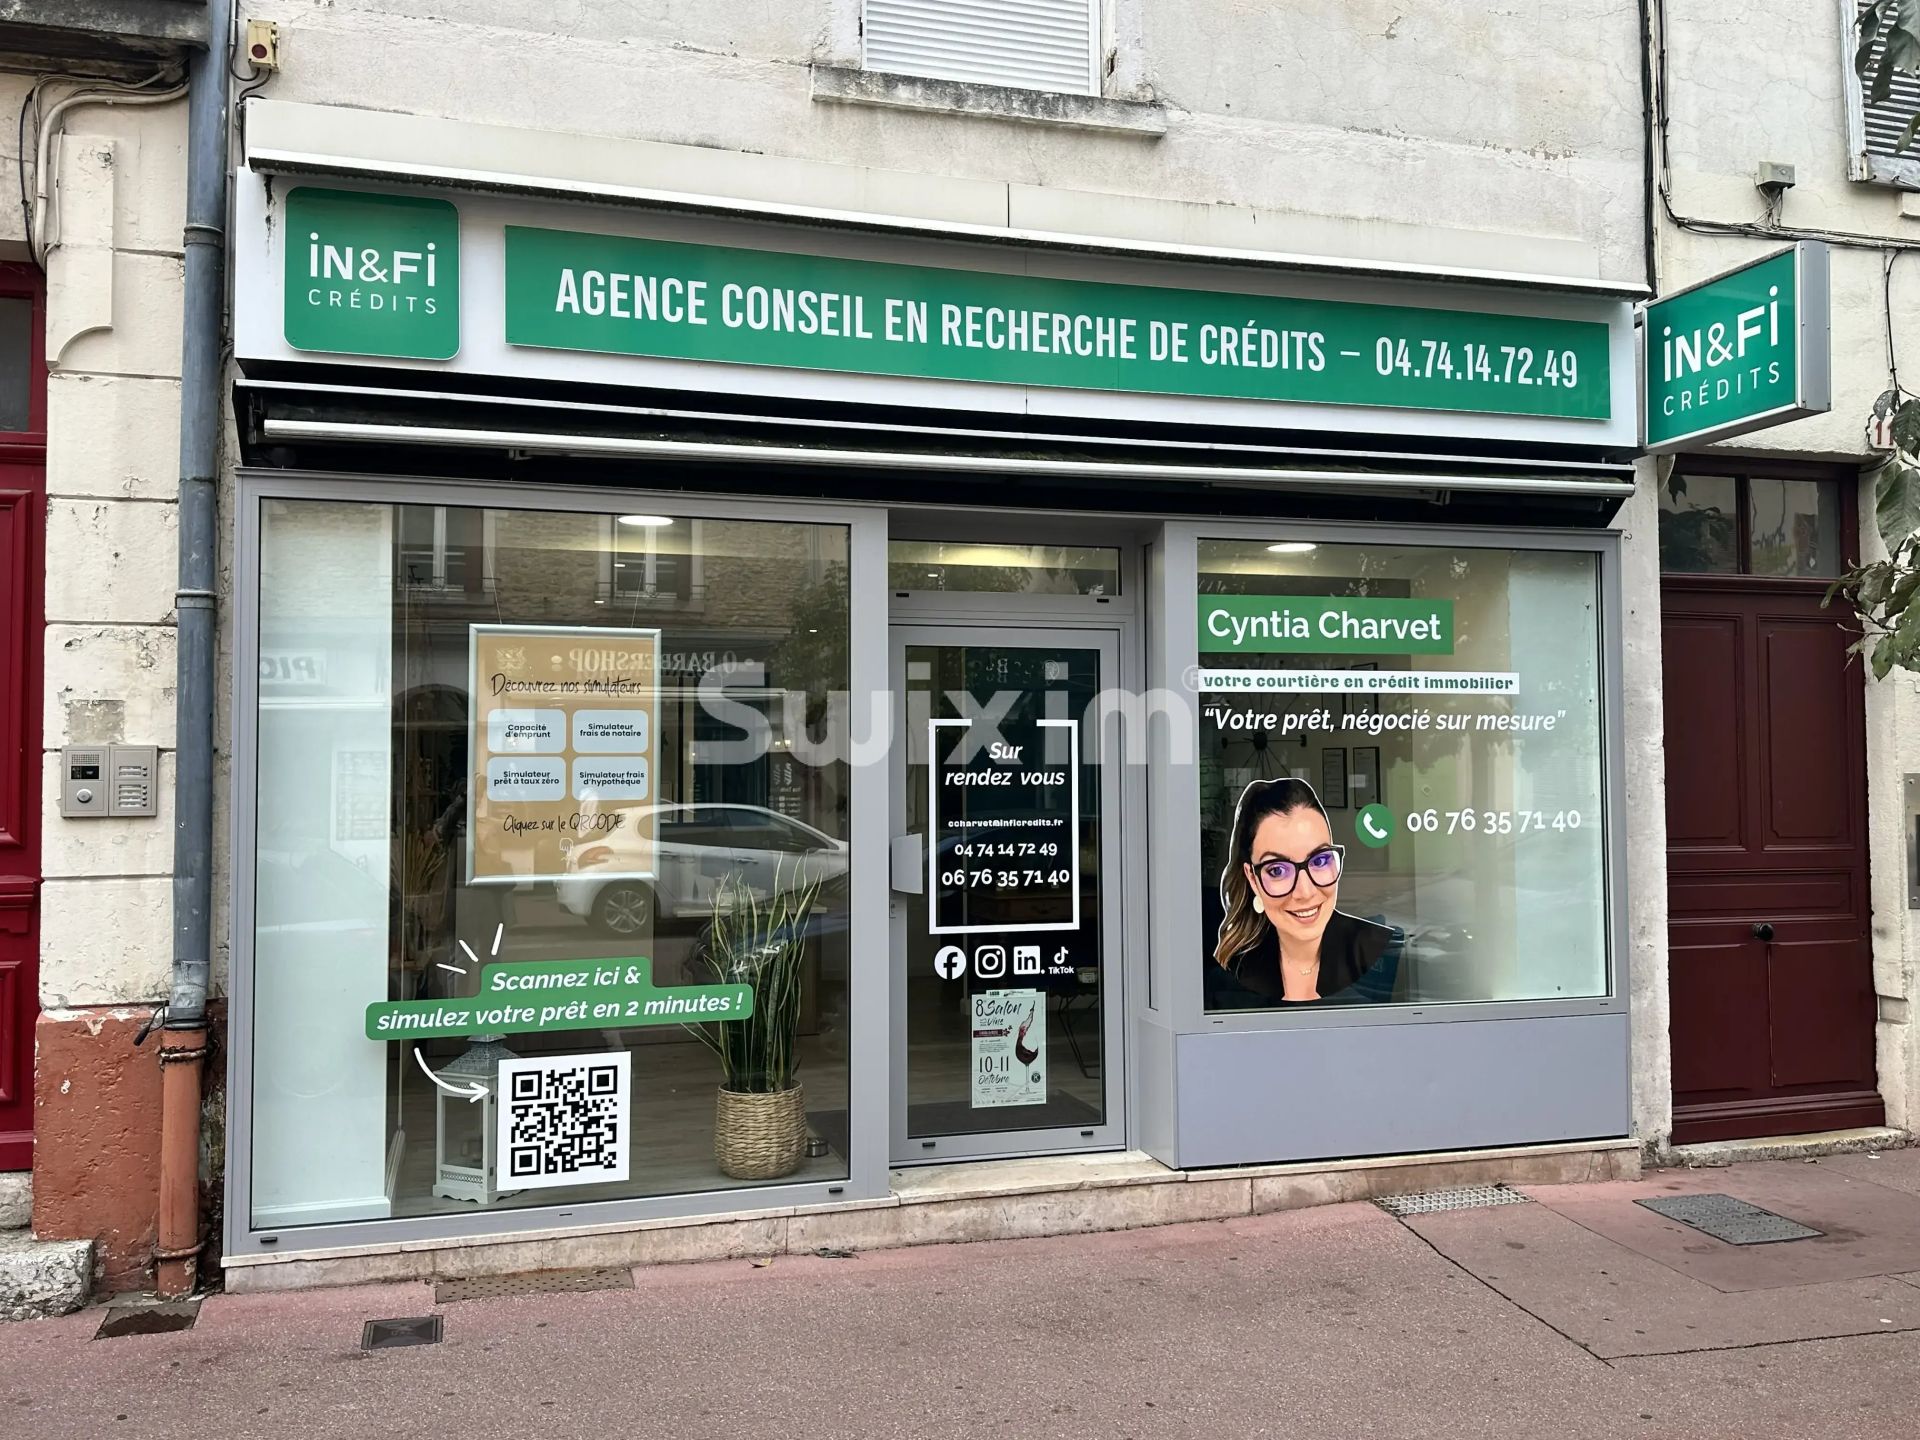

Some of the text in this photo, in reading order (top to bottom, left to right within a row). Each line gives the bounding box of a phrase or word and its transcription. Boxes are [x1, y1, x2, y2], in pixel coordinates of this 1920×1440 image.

[308, 288, 436, 314] CRÉDITS
[555, 267, 707, 325] AGENCE
[722, 282, 873, 339] CONSEIL
[884, 299, 927, 342] EN
[941, 302, 1137, 360] RECHERCHE
[1149, 321, 1188, 362] DE
[1199, 318, 1327, 372] CRÉDITS
[1375, 336, 1579, 388] 04.74.14.72.49
[1662, 362, 1781, 416] CRÉDITS
[1207, 609, 1442, 645] Cyntia Charvet
[491, 673, 642, 697] Découvrez nos simulateurs
[1203, 672, 1514, 691] votre courtière en crédit immobilier
[507, 723, 547, 733] Capacité
[588, 723, 634, 731] Simulateur
[1281, 709, 1335, 735] prêt,
[1341, 709, 1431, 735] négocié
[1435, 714, 1472, 731] sur
[580, 729, 642, 737] frais de notaire
[989, 742, 1023, 760] Sur
[494, 777, 512, 787] prêt
[521, 777, 540, 785] taux
[541, 777, 560, 785] zéro
[503, 770, 550, 778] Simulateur
[579, 770, 645, 779] Simulateur frais
[944, 768, 1065, 787] rendez vous
[504, 815, 539, 838] Cliquez
[541, 820, 554, 831] sur
[557, 815, 566, 831] le
[948, 818, 1064, 828] ccharvet@inficredits.fr
[1406, 808, 1582, 835] 06 76 35 71 40
[954, 843, 1058, 858] 04 74 14 72 49
[941, 868, 1070, 888] 06 76 35 71 40
[490, 966, 641, 992] Scannez ici &
[1048, 966, 1075, 975] TikTok
[377, 992, 744, 1031] simulez votre prêt en 2 minutes !
[984, 999, 1022, 1017] Salon
